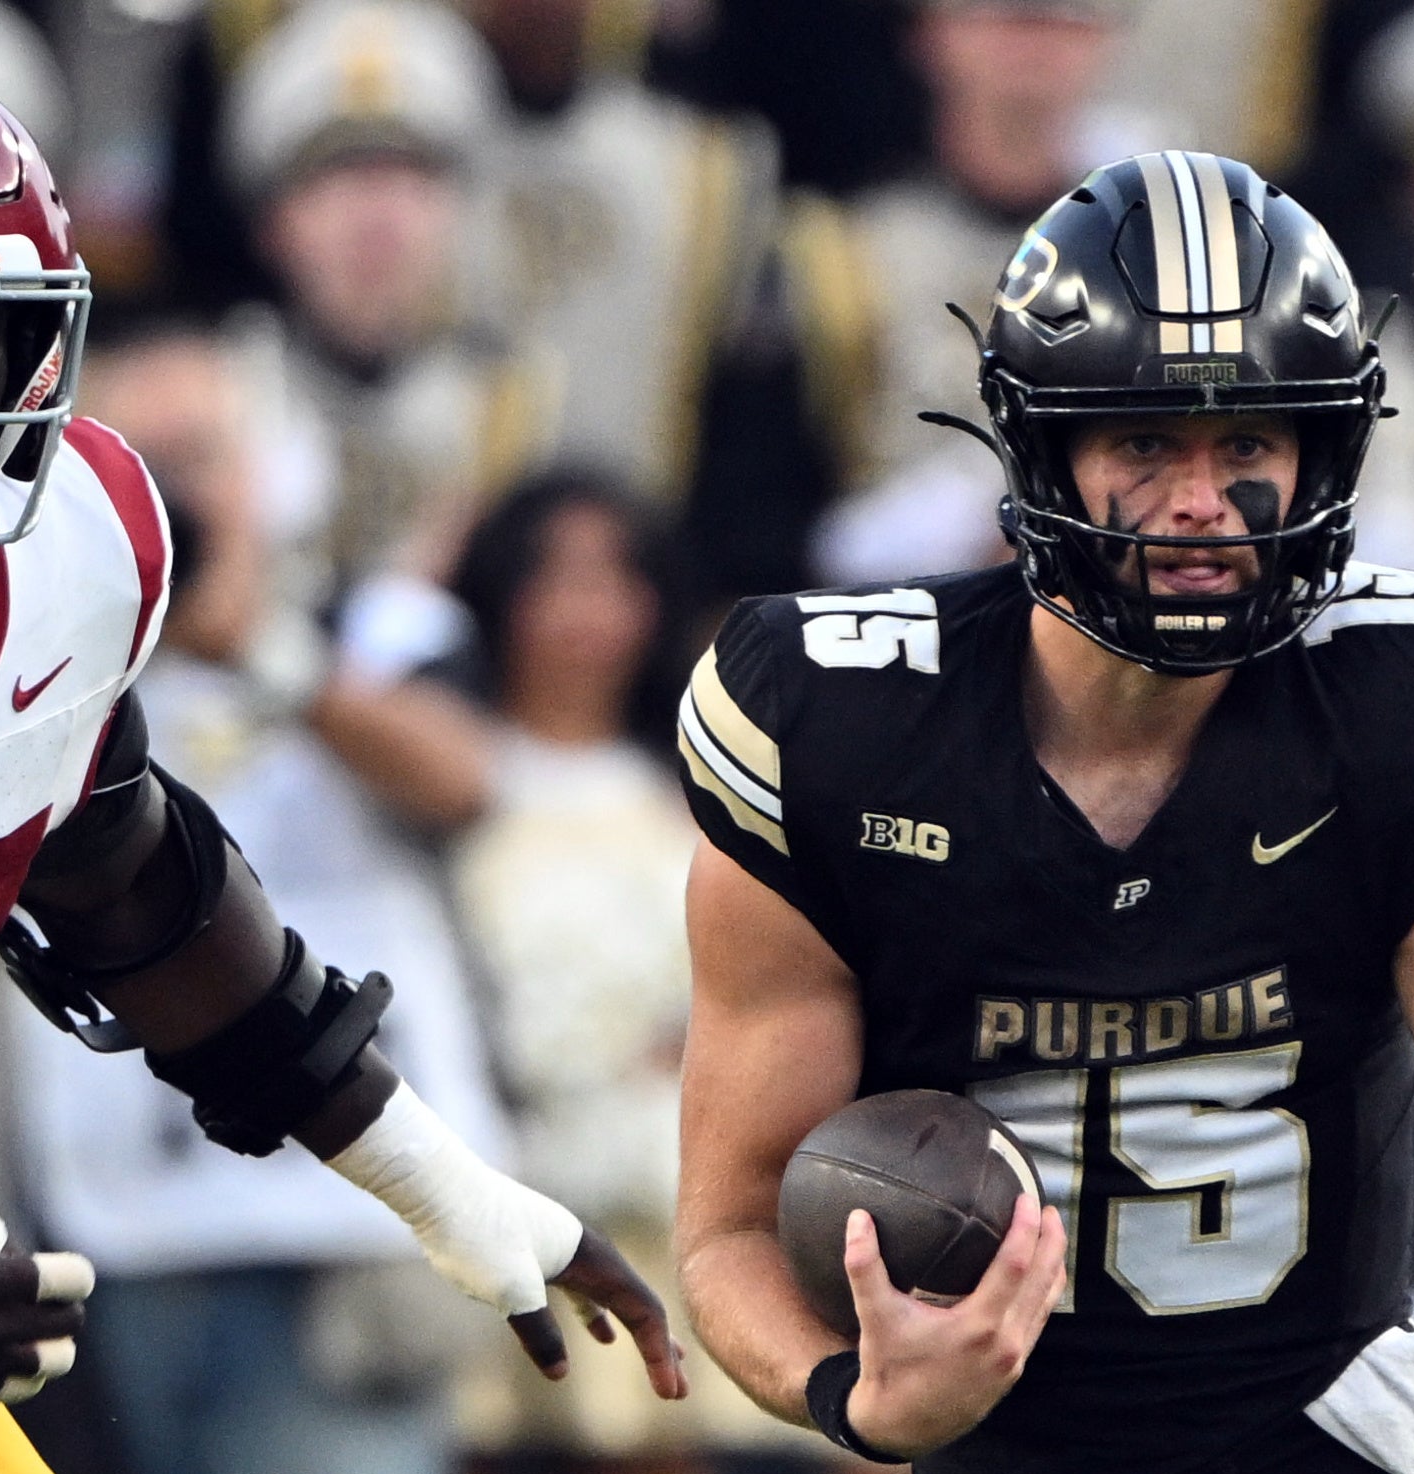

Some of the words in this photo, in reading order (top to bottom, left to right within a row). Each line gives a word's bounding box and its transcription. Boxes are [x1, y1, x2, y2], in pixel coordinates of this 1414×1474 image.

[1164, 362, 1237, 384] PURDUE
[796, 588, 941, 674] 15
[1154, 615, 1204, 630] BOILER
[1206, 616, 1227, 630] UP
[1114, 878, 1150, 909] P
[974, 966, 1291, 1061] PURDUE
